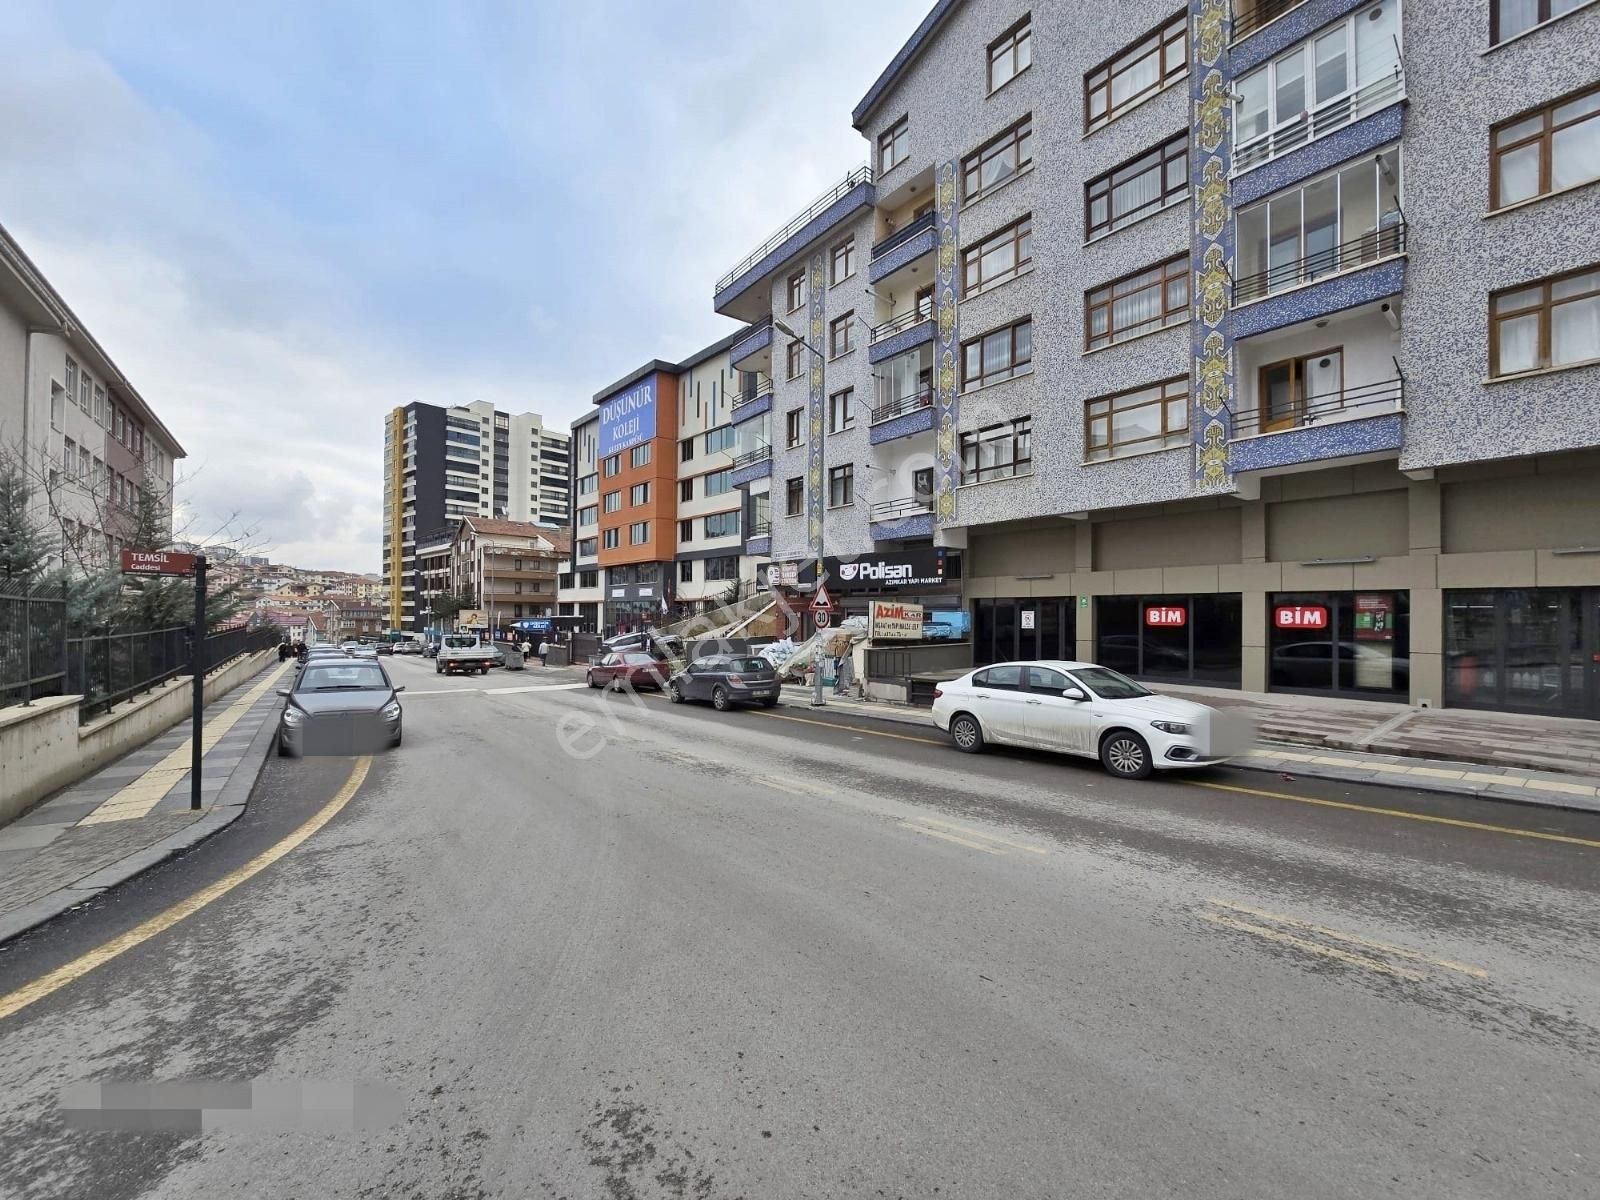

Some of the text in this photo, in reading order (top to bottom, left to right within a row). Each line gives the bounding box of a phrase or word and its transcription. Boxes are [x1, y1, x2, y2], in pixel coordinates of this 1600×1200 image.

[602, 384, 652, 425] DÜŞÜNÜR
[613, 414, 640, 441] KOLEJİ
[131, 552, 170, 563] TEMSİL
[131, 563, 160, 571] Caddesi
[860, 561, 912, 580] Polisan
[817, 612, 826, 623] 30
[876, 604, 904, 620] AZİM
[1149, 607, 1181, 623] BİM
[1280, 606, 1322, 625] BİM
